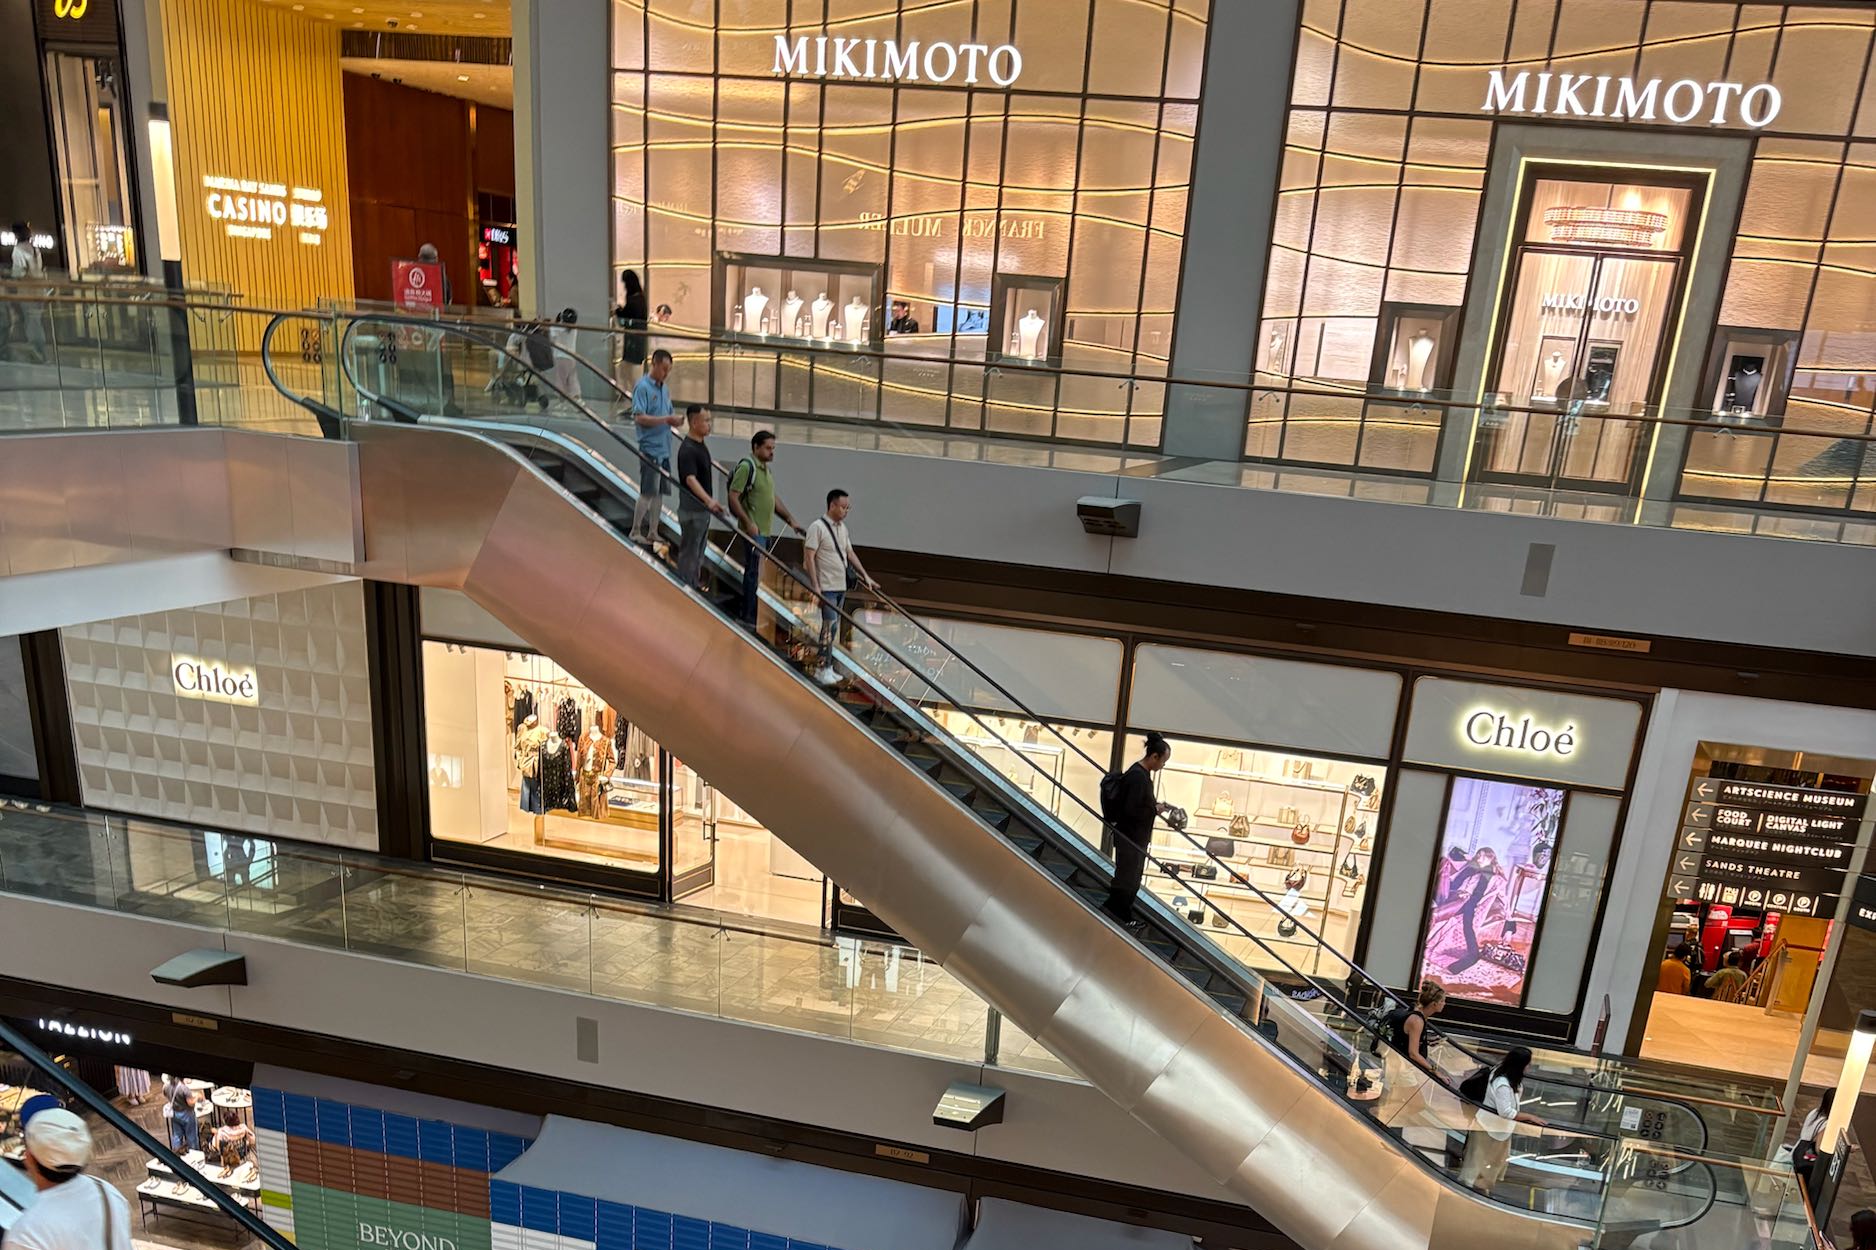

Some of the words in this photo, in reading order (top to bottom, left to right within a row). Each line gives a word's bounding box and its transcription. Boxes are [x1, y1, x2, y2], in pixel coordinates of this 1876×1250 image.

[771, 35, 1022, 86] MIKIMOTO
[1480, 71, 1782, 127] MIKIMOTO
[207, 193, 287, 225] CASINO
[175, 663, 254, 698] Chloé
[1466, 712, 1574, 754] Chloé
[1723, 785, 1799, 802] ARTSCIENCE
[1803, 794, 1855, 807] MUSEUM
[1716, 816, 1752, 827] COURT
[1717, 809, 1748, 819] FOOD
[1766, 815, 1809, 827] DIGITAL
[1811, 819, 1844, 830] LIGHT
[1765, 823, 1807, 833] CANVAS
[1711, 835, 1768, 851] MARQUEE
[1771, 843, 1843, 859] NIGHTCLUB
[1705, 859, 1743, 873] SANDS
[1748, 865, 1801, 880] THEATRE
